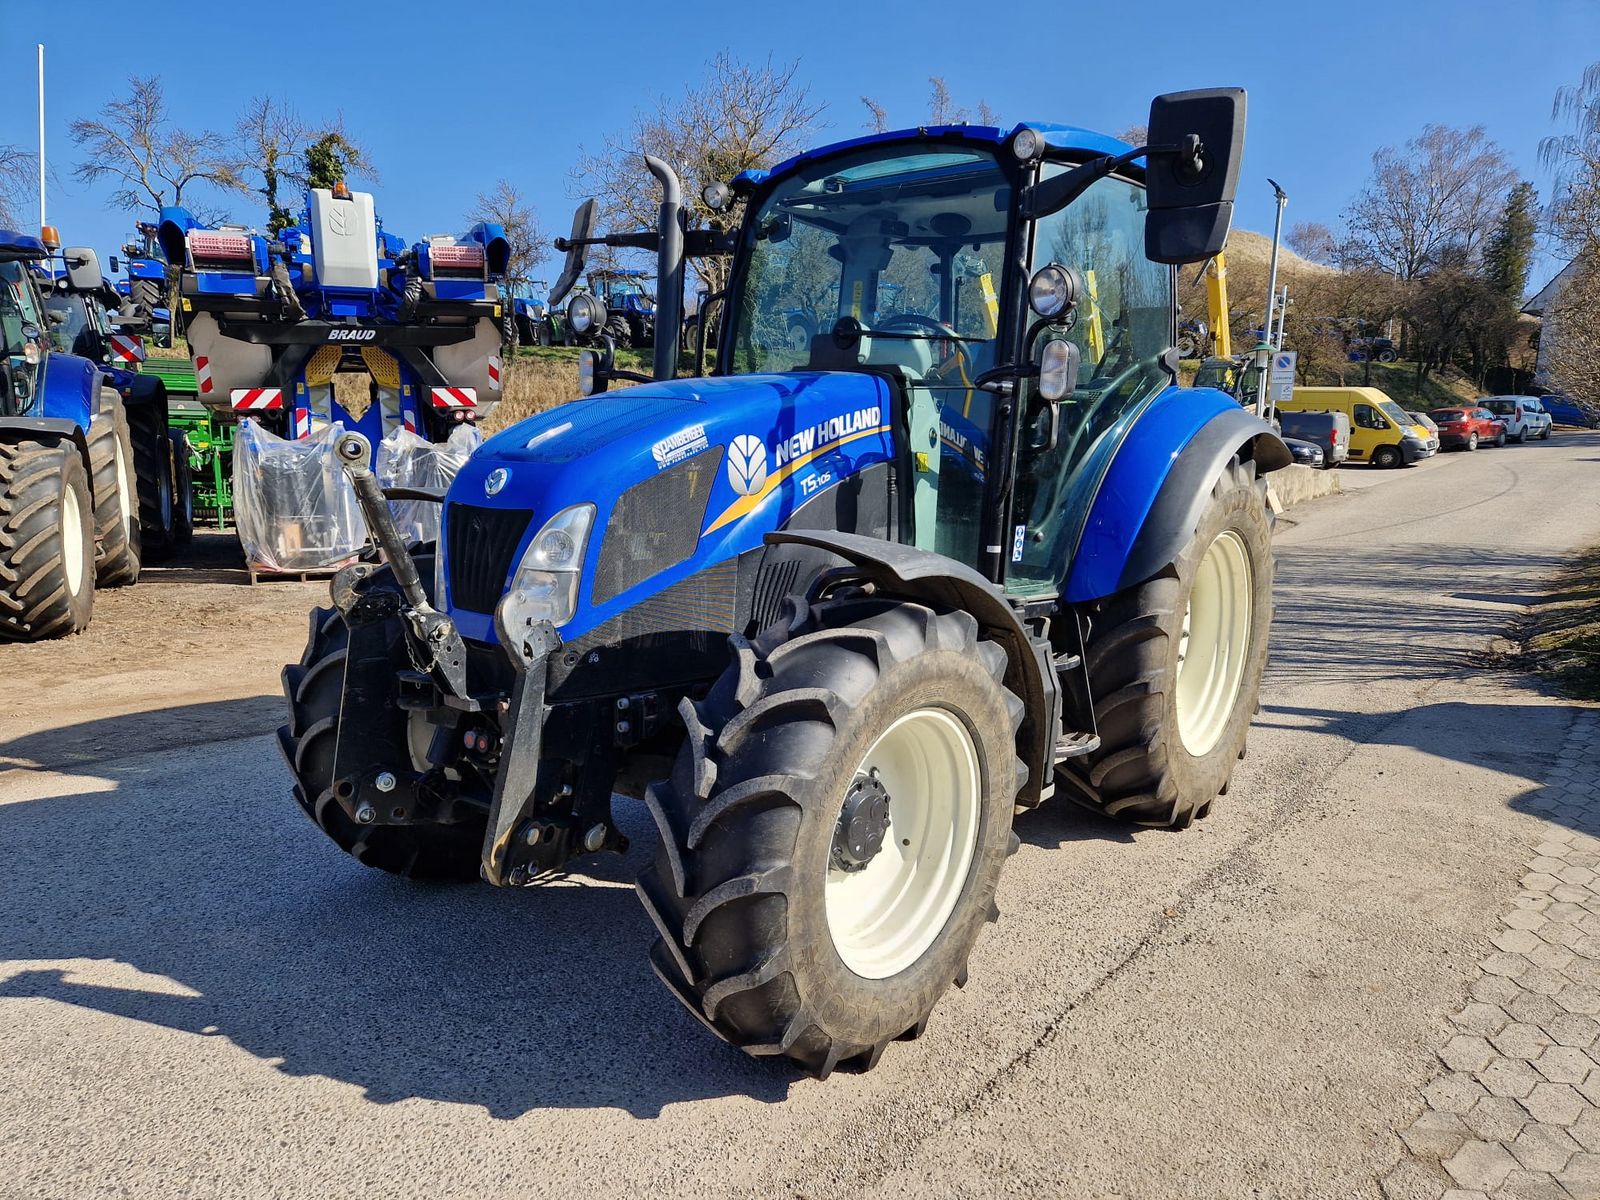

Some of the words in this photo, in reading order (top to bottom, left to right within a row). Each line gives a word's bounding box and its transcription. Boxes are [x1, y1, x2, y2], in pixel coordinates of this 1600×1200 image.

[328, 329, 376, 340] BRAUD
[776, 426, 815, 467] NEW
[817, 406, 881, 445] HOLLAND
